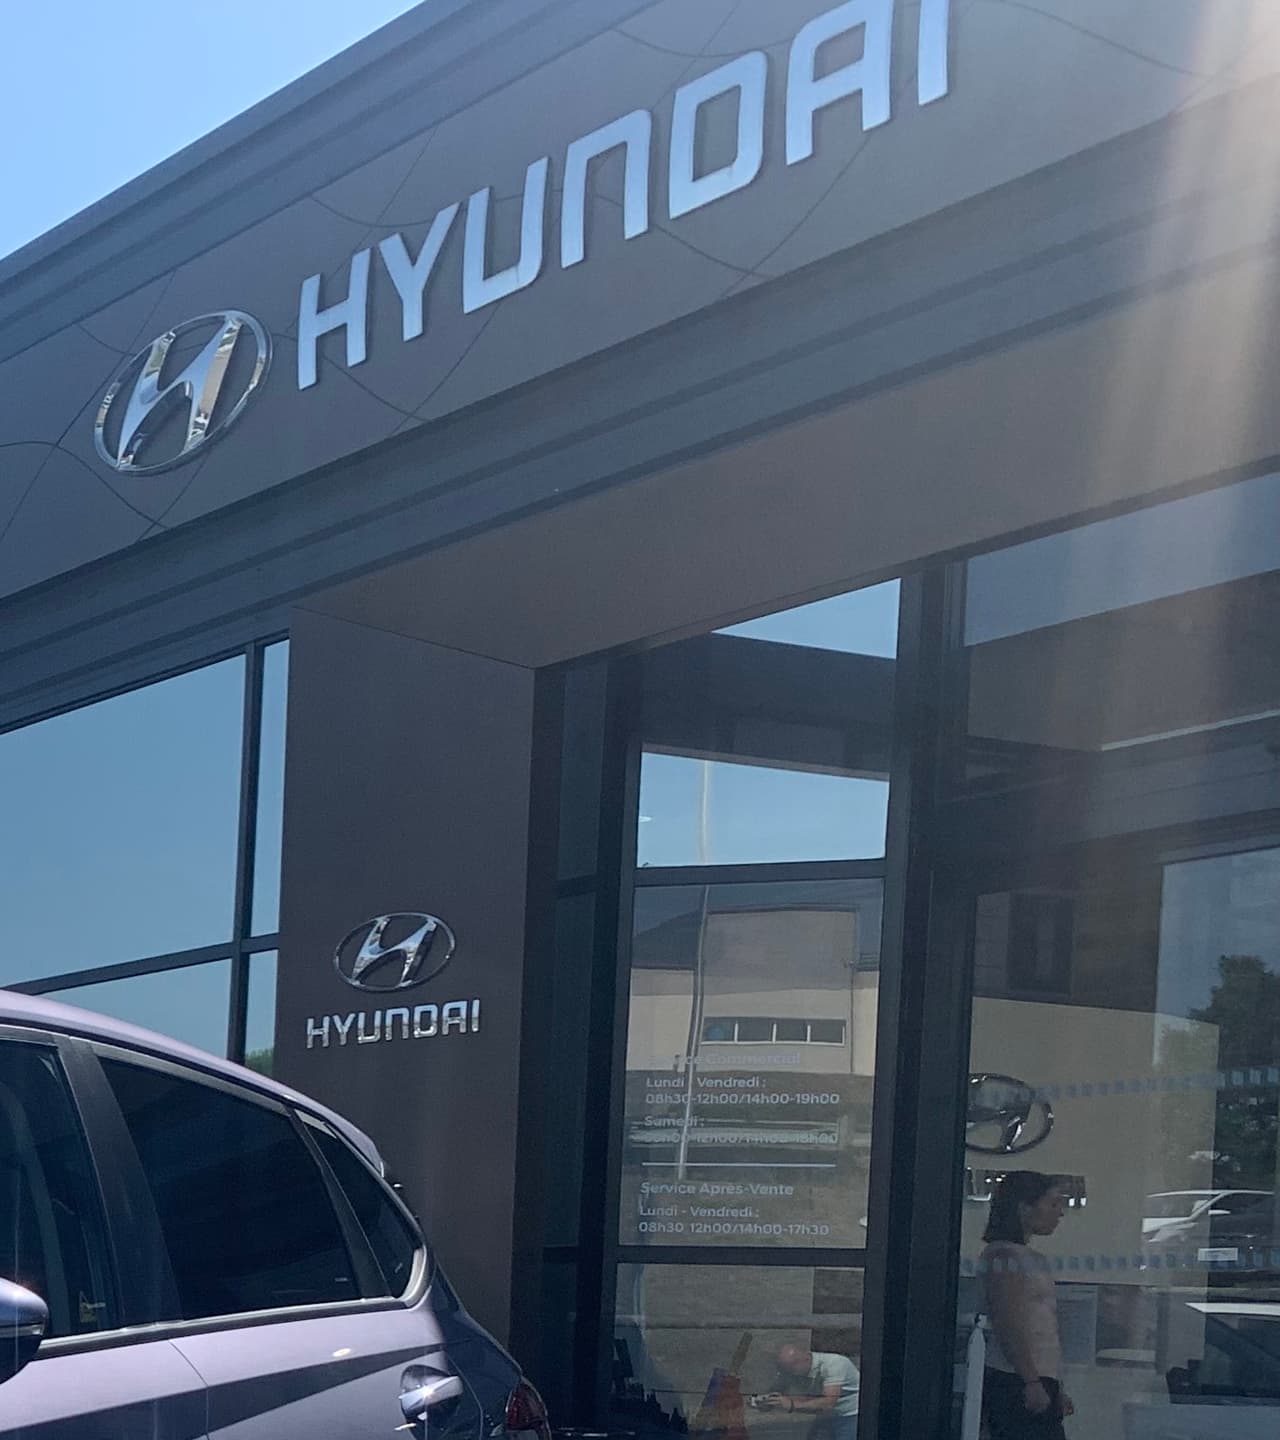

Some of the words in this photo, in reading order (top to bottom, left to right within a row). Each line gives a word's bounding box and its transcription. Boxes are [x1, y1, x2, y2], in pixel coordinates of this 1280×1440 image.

[297, 0, 954, 391] HYUNDAI
[306, 998, 481, 1049] HYUNDAI
[646, 1076, 685, 1088] Lundi
[697, 1076, 760, 1088] Vendredi
[640, 1182, 696, 1194] Service
[700, 1182, 794, 1196] Après-Vente
[640, 1205, 678, 1217] Lundi
[689, 1205, 753, 1217] Vendredi
[639, 1221, 830, 1235] 08h3012h00/14h00-17h30
